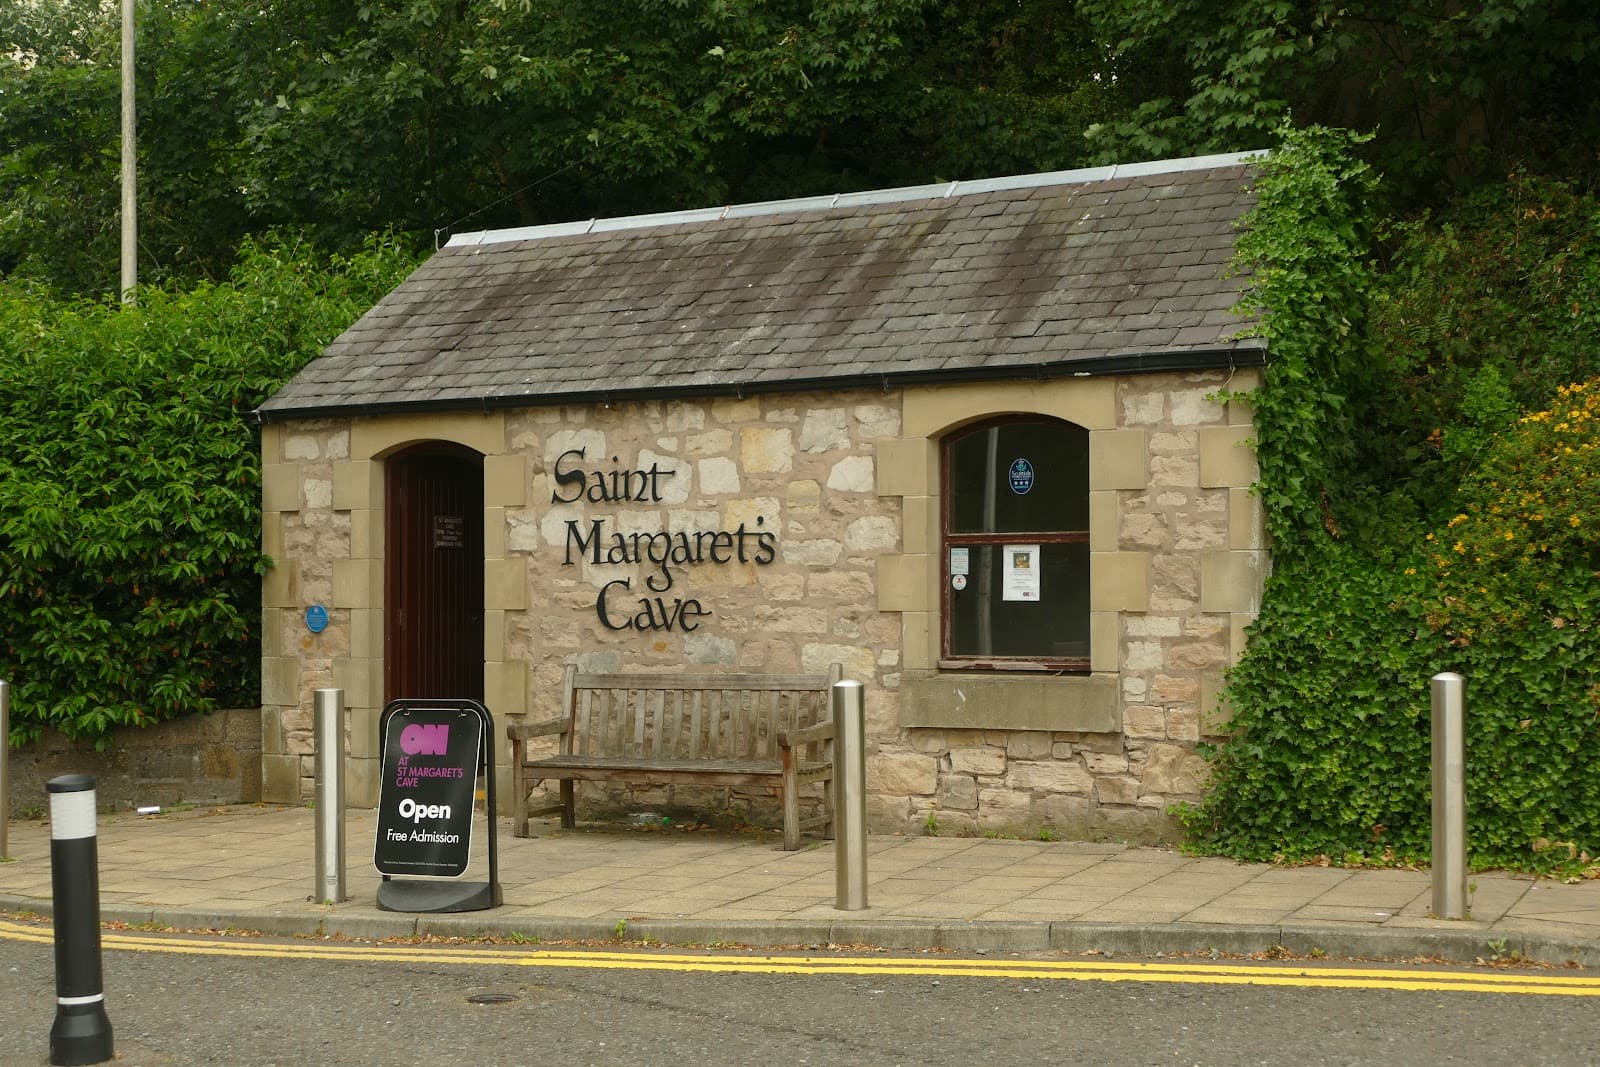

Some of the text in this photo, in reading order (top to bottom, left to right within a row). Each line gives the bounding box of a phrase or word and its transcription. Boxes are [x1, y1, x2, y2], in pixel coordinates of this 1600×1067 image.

[551, 446, 676, 504] Saint
[561, 515, 776, 592] Margaret's
[596, 577, 712, 632] Cave
[400, 723, 449, 755] ON
[397, 767, 407, 777] ST
[398, 756, 409, 766] AT
[396, 777, 418, 788] CAVE
[398, 798, 451, 824] Open
[387, 828, 459, 844] Free Admission
